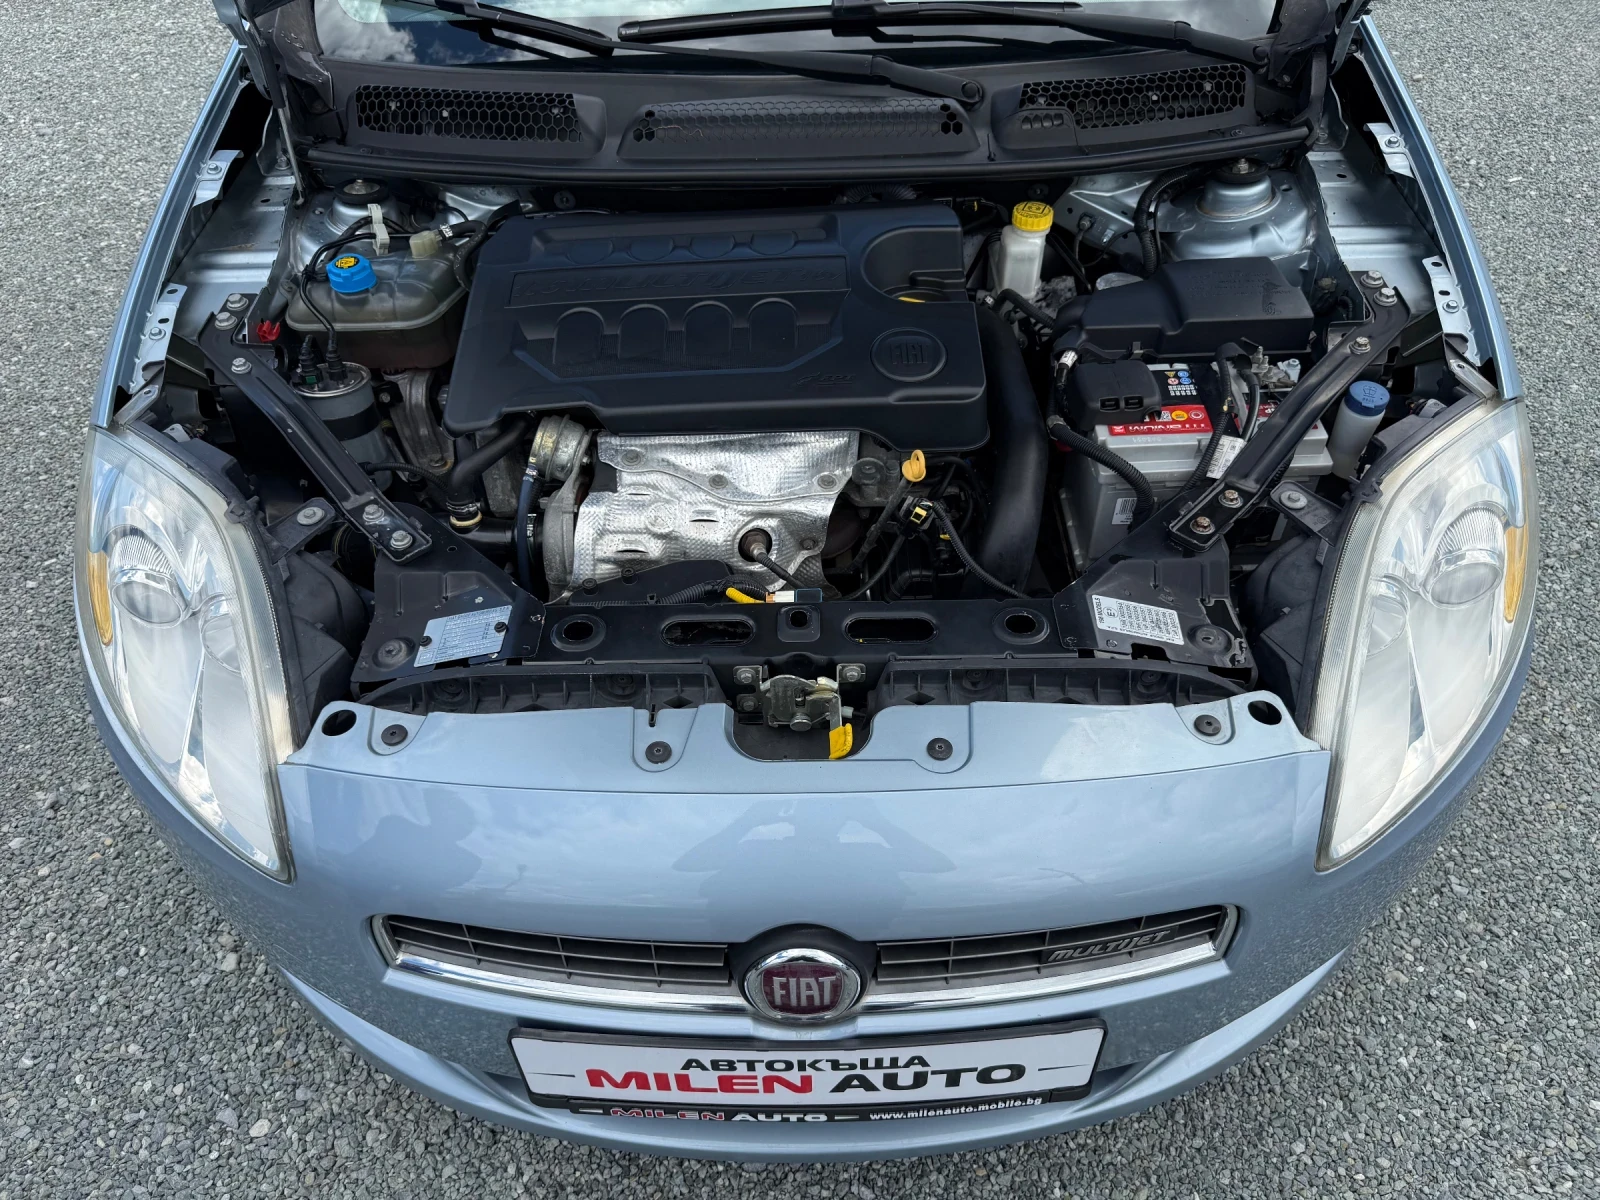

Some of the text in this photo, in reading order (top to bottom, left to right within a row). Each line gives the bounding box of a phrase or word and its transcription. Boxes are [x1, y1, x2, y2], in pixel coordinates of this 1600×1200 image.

[889, 341, 931, 364] FIAT
[1048, 930, 1171, 962] MULTIJET
[772, 976, 837, 1007] FIAT
[585, 1063, 1026, 1094] MILEN AUTO
[610, 1107, 828, 1122] MILEN AUTO
[869, 1096, 1043, 1121] www.milenauto.mobile.bg
